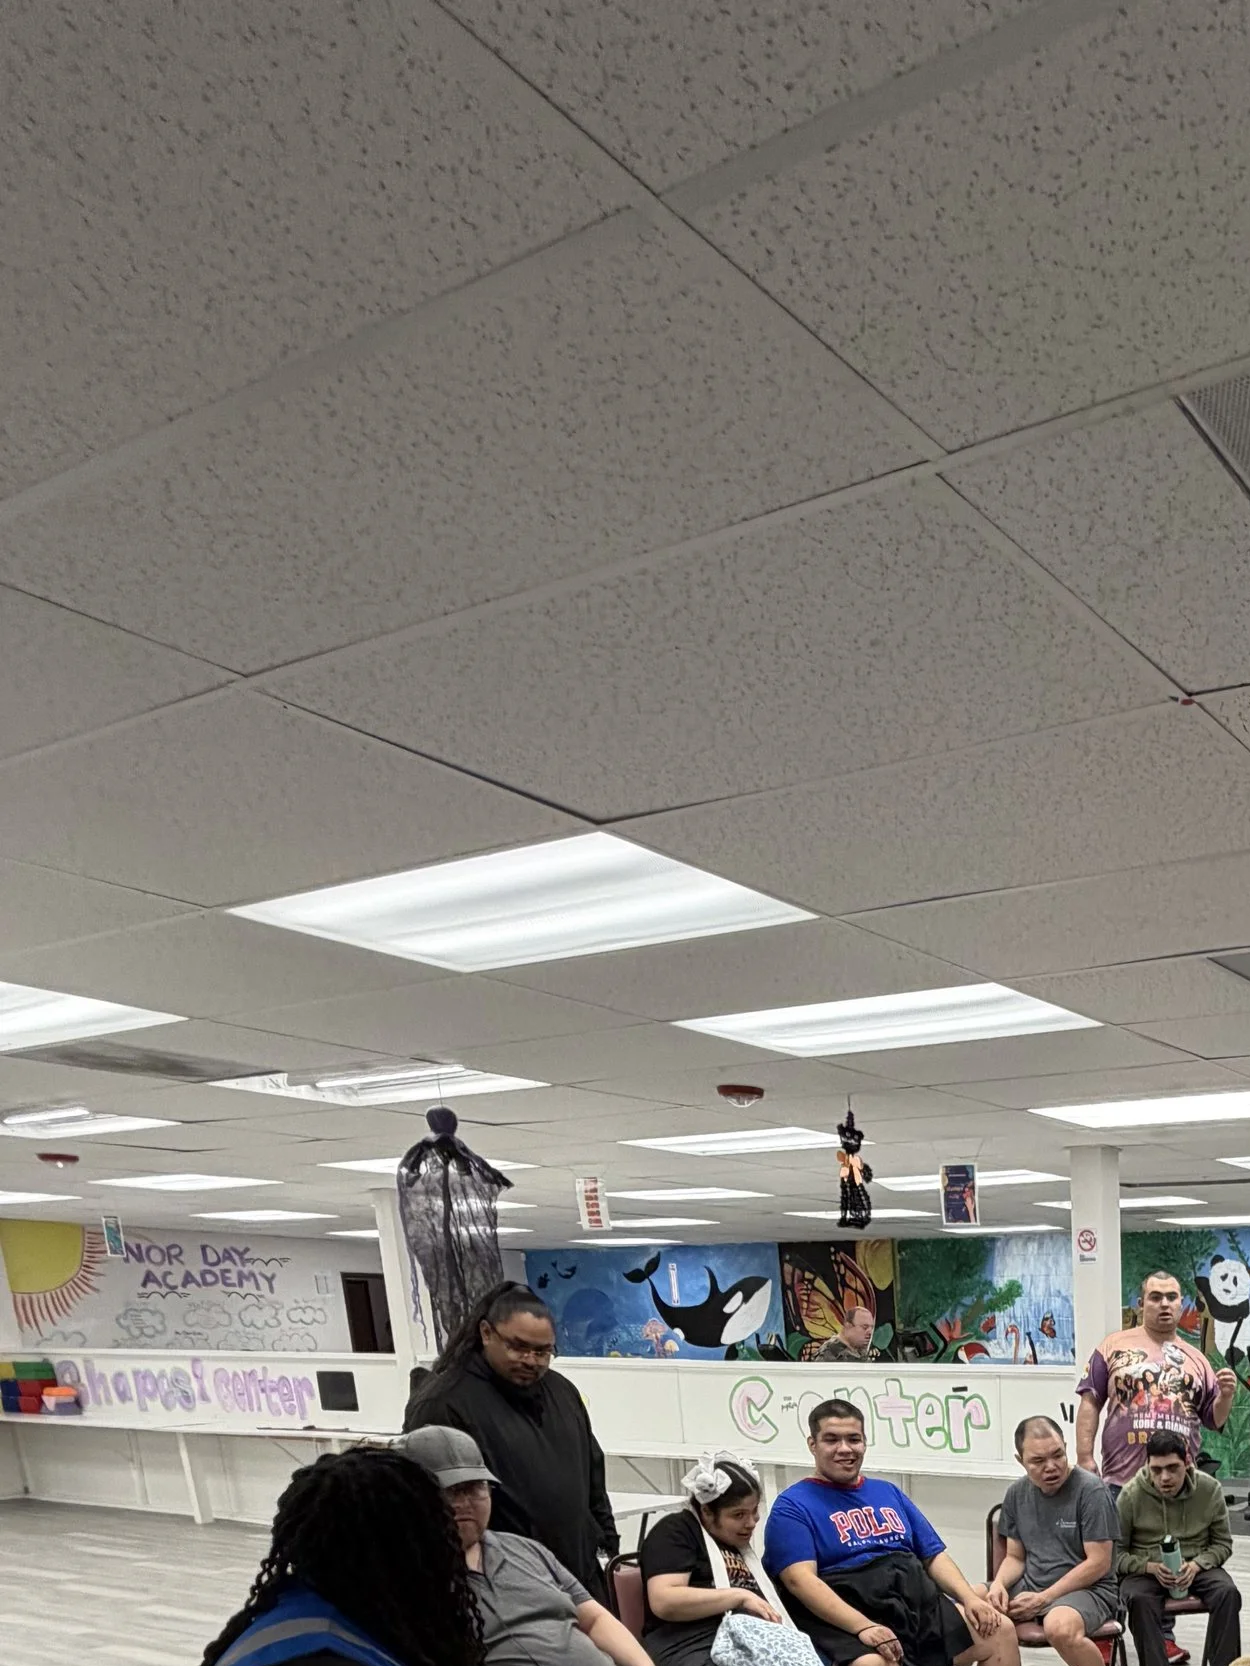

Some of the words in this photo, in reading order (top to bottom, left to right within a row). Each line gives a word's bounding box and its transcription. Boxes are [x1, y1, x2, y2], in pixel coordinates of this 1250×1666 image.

[123, 1242, 184, 1266] NOR
[201, 1244, 251, 1267] DAY
[141, 1268, 276, 1294] ACADEMY
[1133, 1418, 1155, 1430] KOBE
[1156, 1420, 1164, 1430] &
[829, 1506, 906, 1543] POLO
